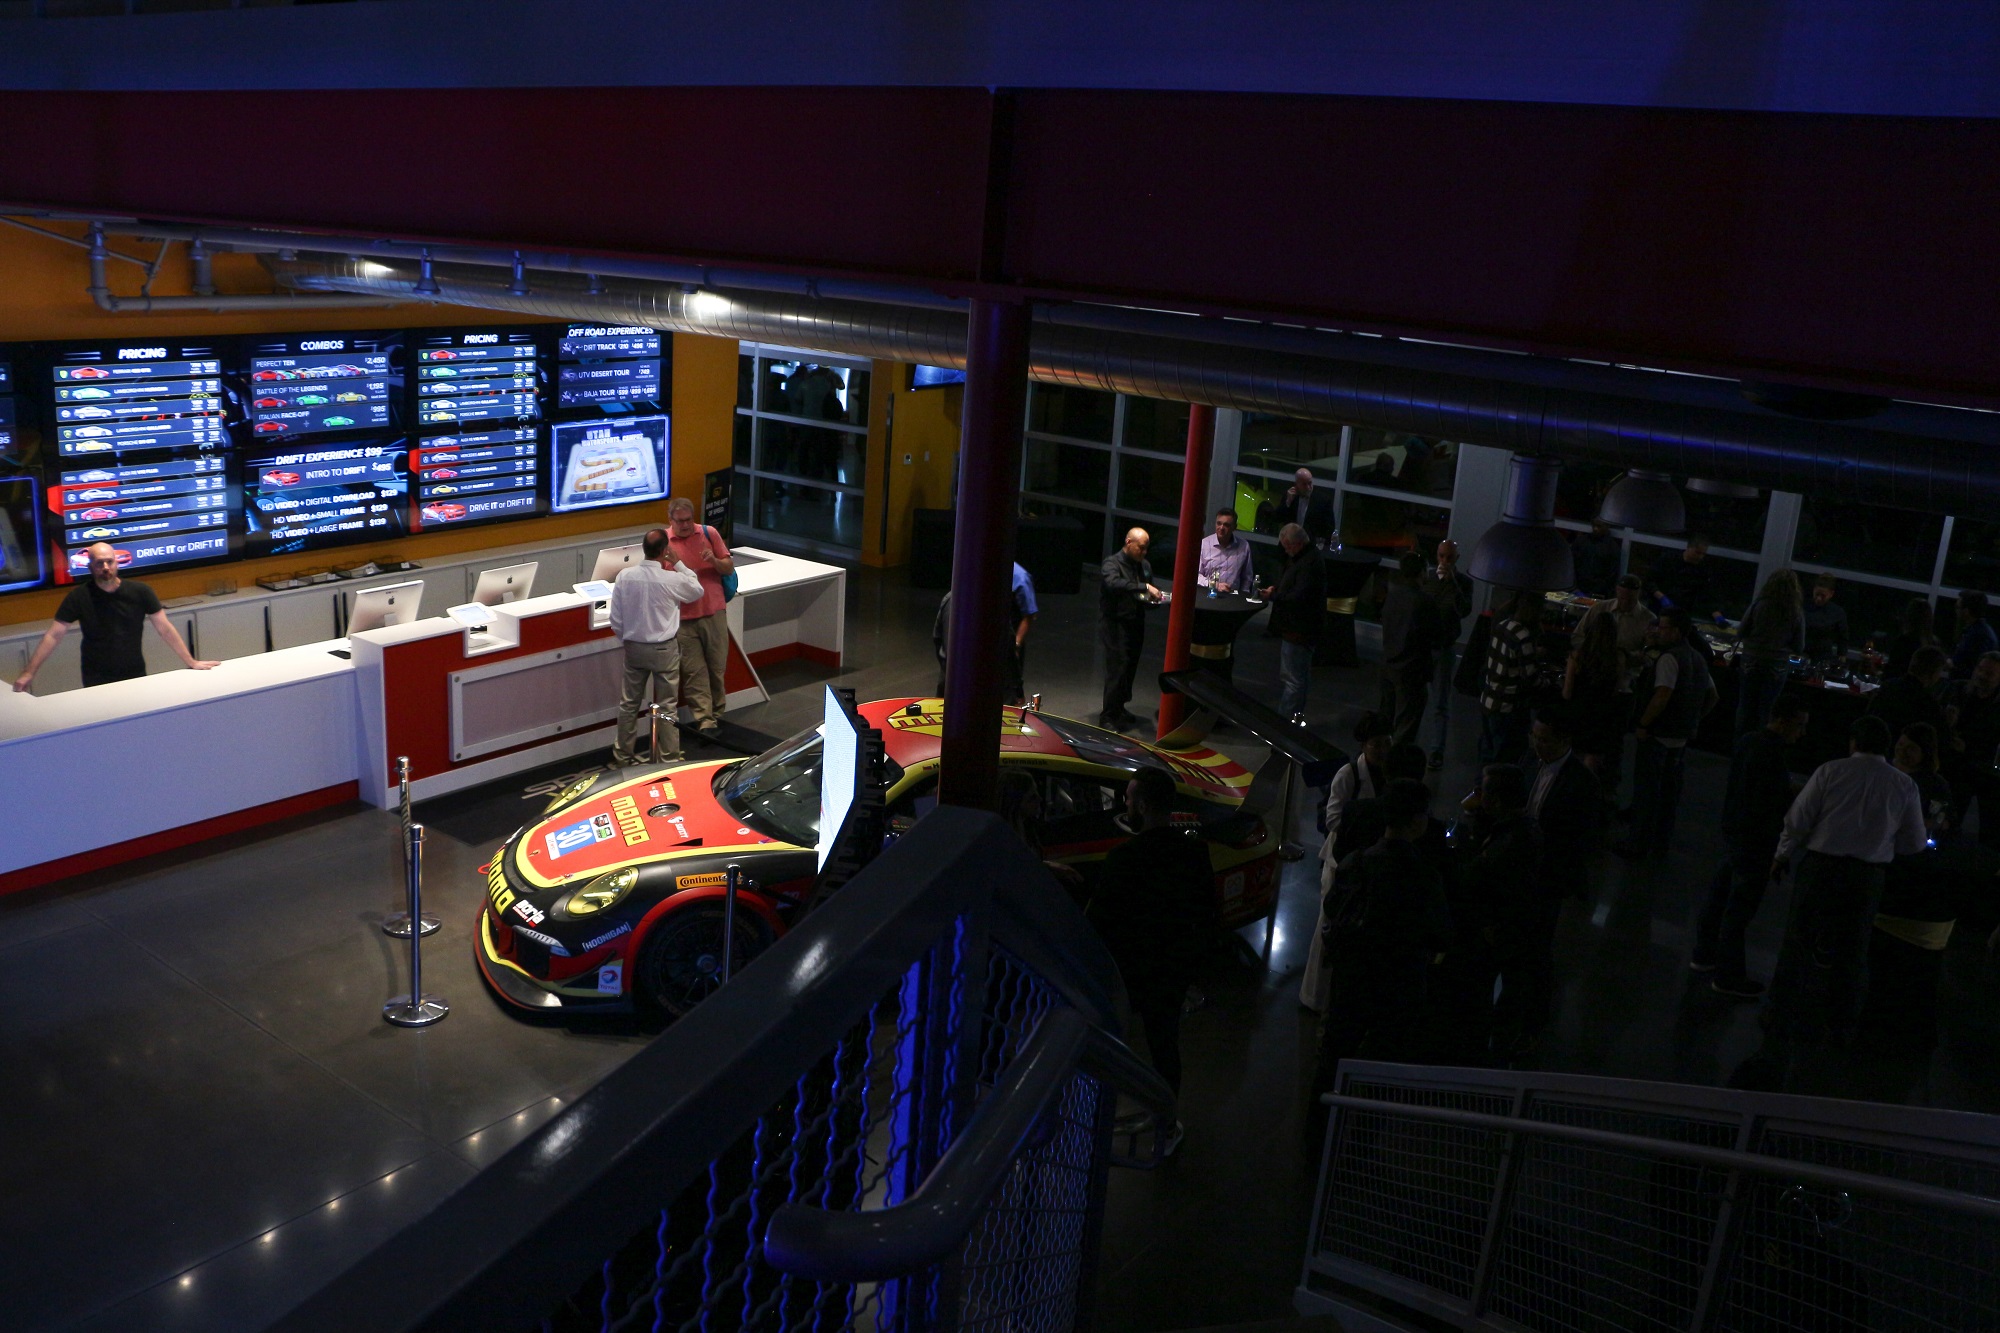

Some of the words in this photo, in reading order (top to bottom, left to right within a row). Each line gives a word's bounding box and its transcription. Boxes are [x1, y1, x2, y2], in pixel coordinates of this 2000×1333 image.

[464, 334, 498, 344] PRICING
[568, 328, 584, 336] OFF
[584, 328, 606, 336] ROAD
[300, 340, 344, 351] COMBOS
[118, 348, 167, 360] PRICING
[256, 388, 278, 396] BATTLE
[586, 428, 610, 440] UTAH
[276, 454, 305, 465] DRIFT
[306, 448, 364, 462] EXPERIENCE
[364, 446, 383, 457] $99
[306, 470, 330, 479] INTRO
[331, 468, 342, 476] TO
[343, 466, 366, 476] DRIFT
[372, 462, 392, 472] $495
[262, 502, 274, 512] HD
[274, 500, 299, 510] VIDEO
[306, 496, 332, 506] DIGITAL
[333, 492, 376, 503] DOWNLOAD
[380, 489, 398, 498] $129
[470, 503, 490, 512] DRIVE
[506, 498, 525, 508] DRIFT
[273, 516, 285, 524] HD
[286, 513, 310, 522] VIDEO
[317, 510, 340, 518] SMALL
[340, 506, 366, 516] FRAME
[370, 504, 388, 512] $129
[272, 530, 284, 539] HD
[284, 527, 309, 537] VIDEO
[314, 523, 338, 533] LARGE
[338, 520, 364, 530] FRAME
[369, 518, 387, 527] $139
[136, 545, 165, 558] DRIVE
[166, 544, 176, 555] IT
[177, 545, 187, 553] or
[188, 540, 213, 551] DRIFT
[214, 538, 224, 548] IT
[556, 824, 594, 850] 30
